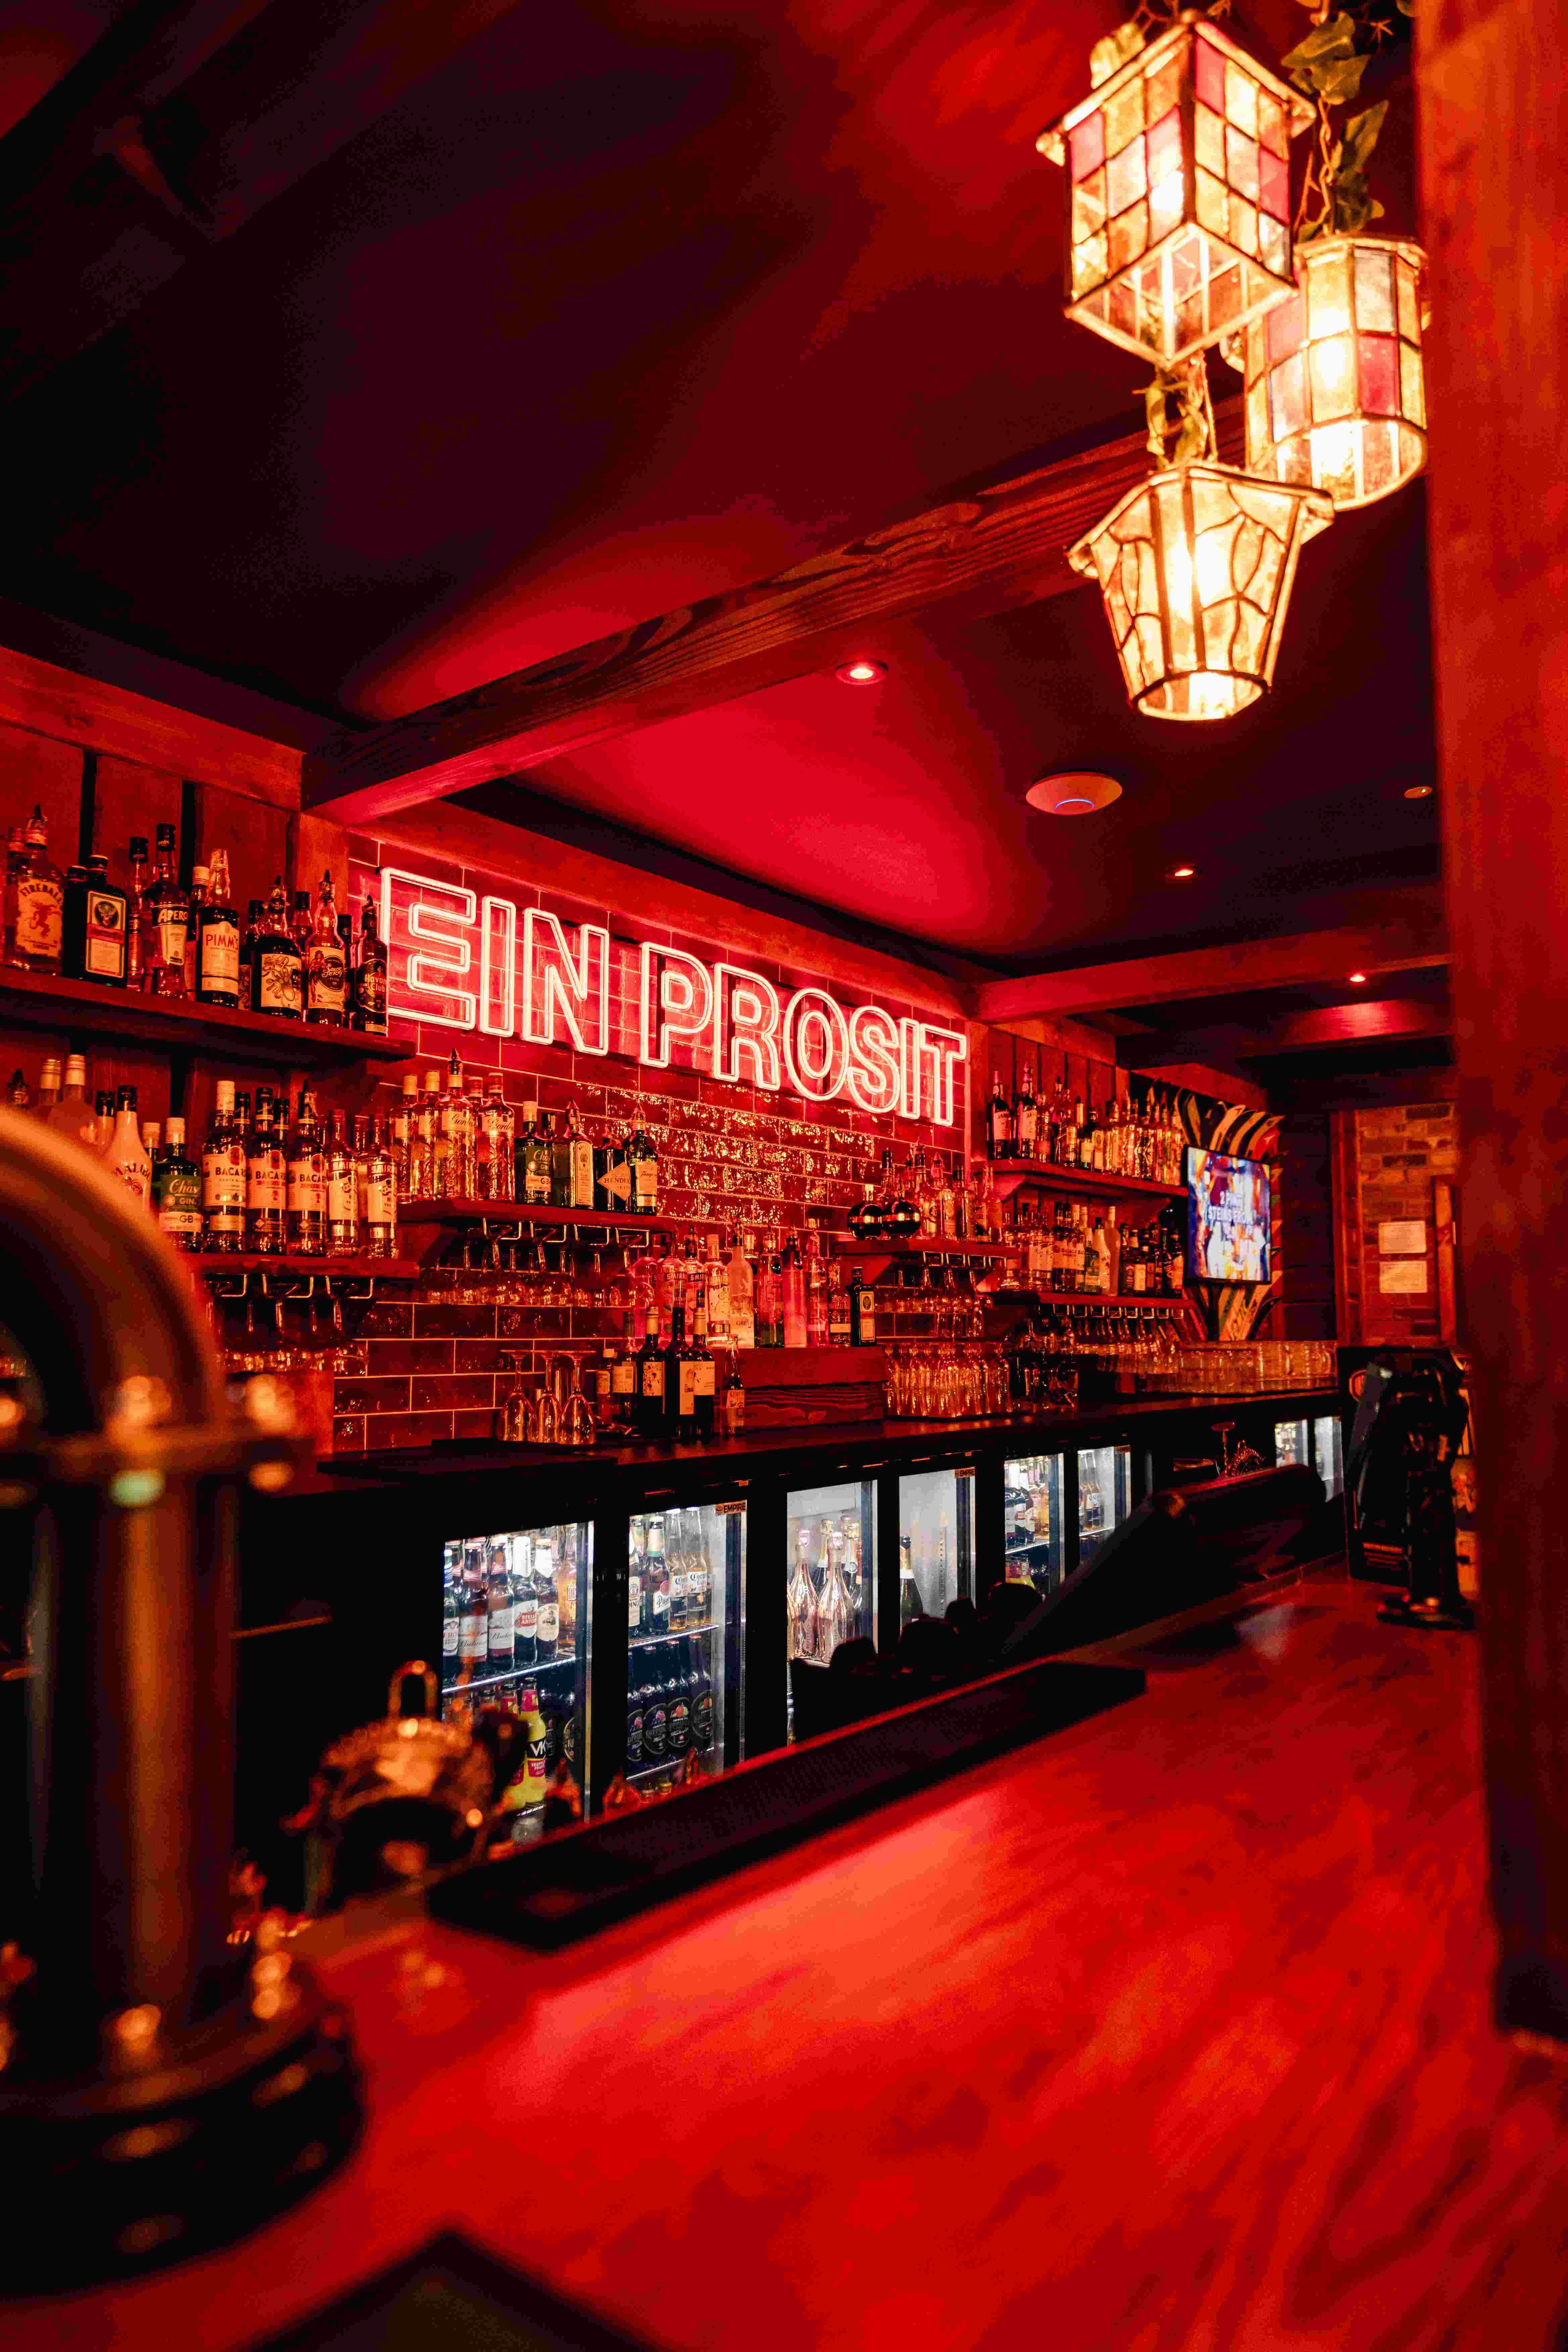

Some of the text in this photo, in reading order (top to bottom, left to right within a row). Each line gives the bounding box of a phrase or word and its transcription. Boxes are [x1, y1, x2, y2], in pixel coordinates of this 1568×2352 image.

[205, 933, 239, 950] PIMM'S
[372, 983, 385, 992] Club
[379, 867, 966, 1126] EIN PROSIT
[179, 1215, 194, 1223] GB
[724, 1503, 746, 1513] EMPIRE
[530, 1740, 546, 1757] VK
